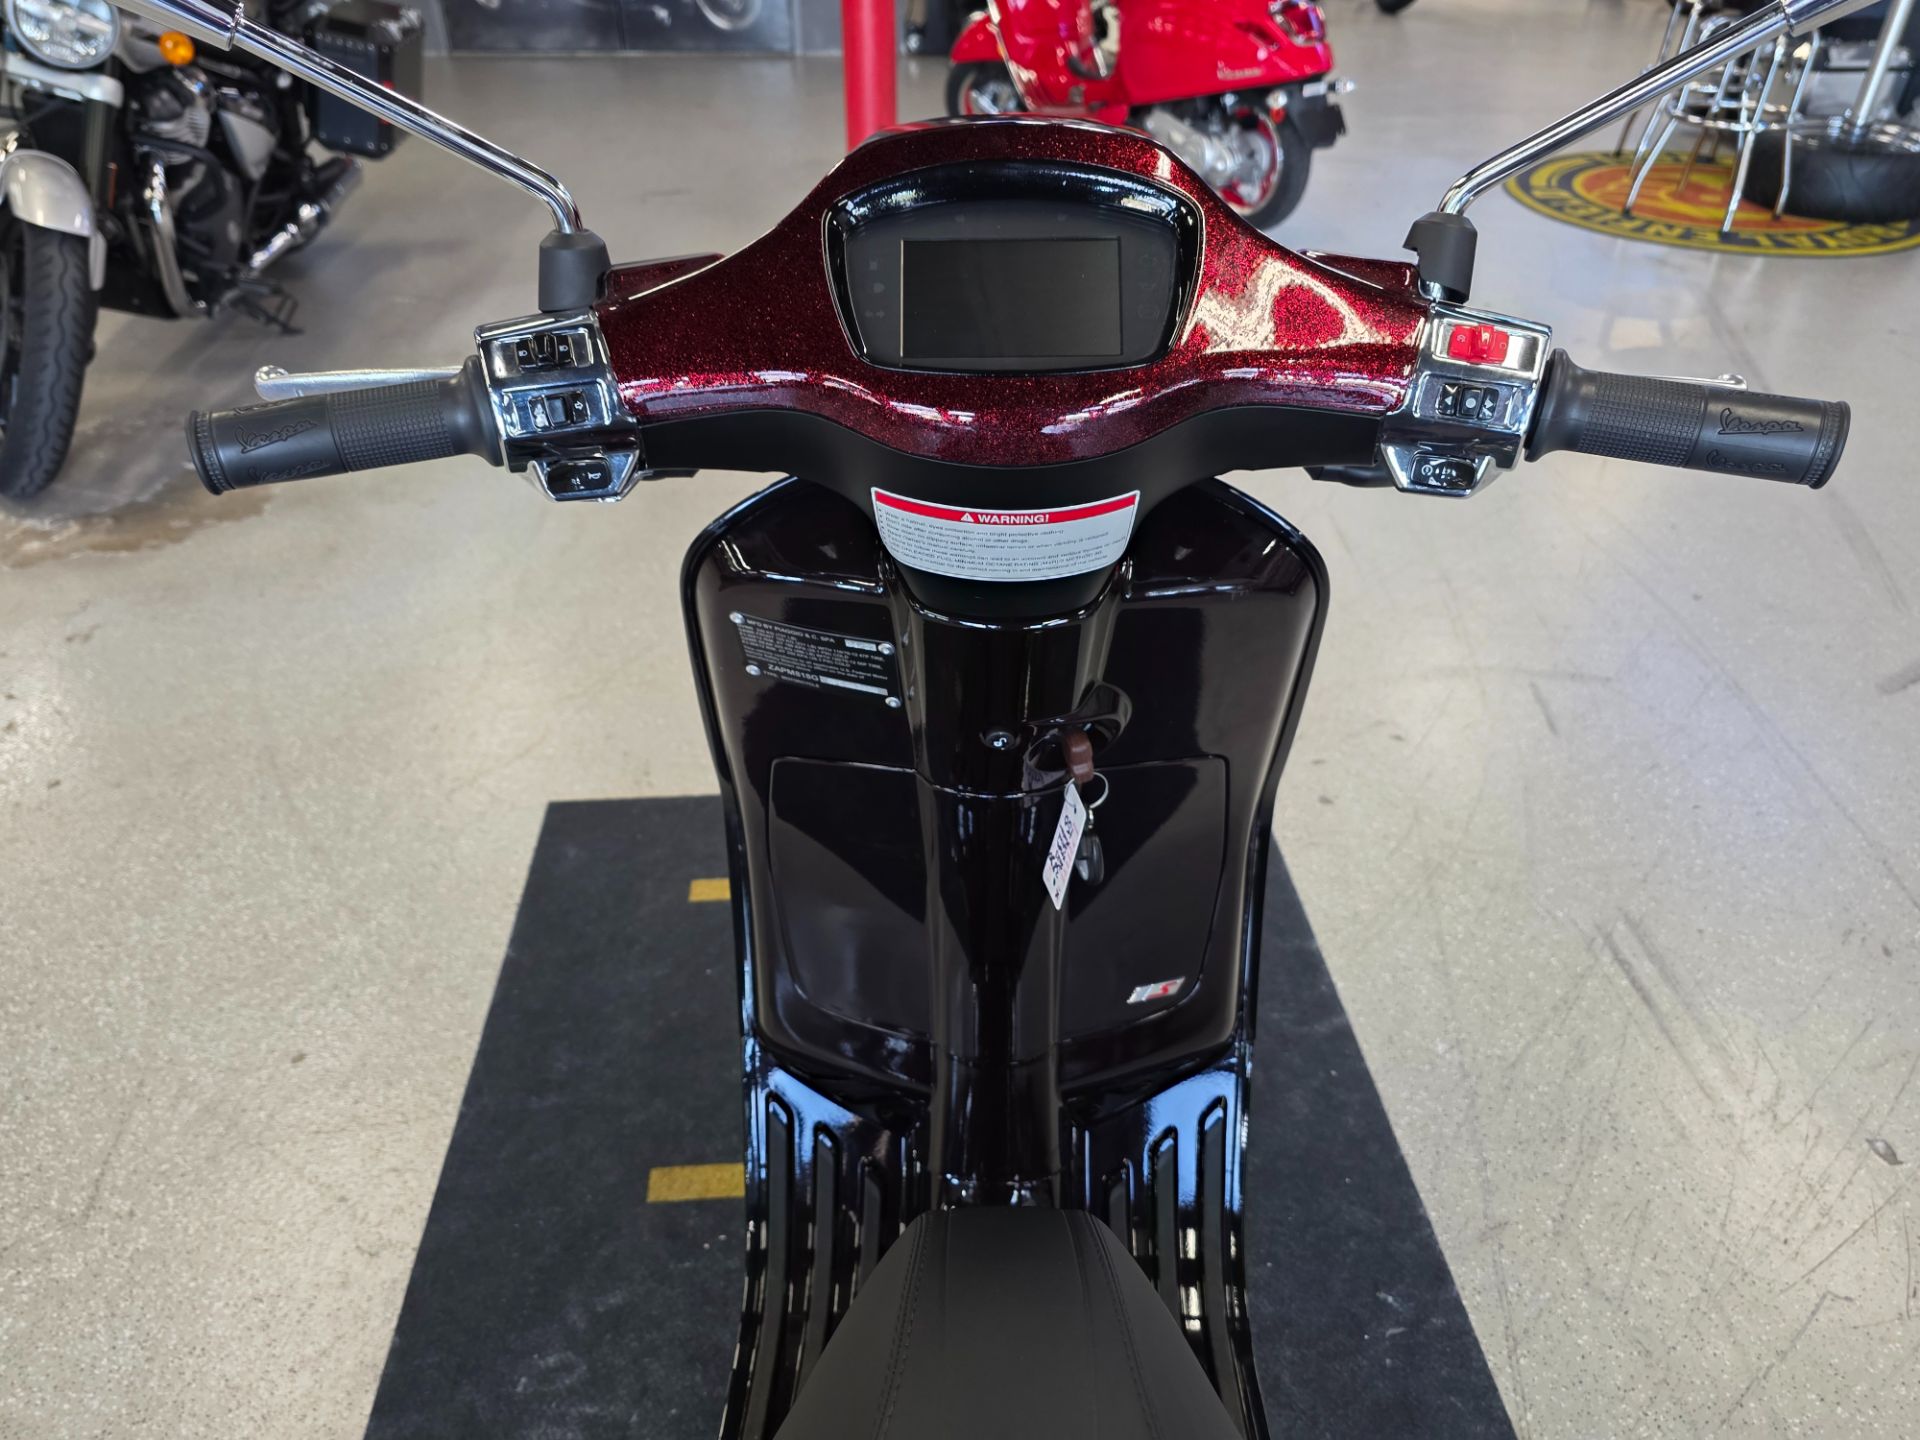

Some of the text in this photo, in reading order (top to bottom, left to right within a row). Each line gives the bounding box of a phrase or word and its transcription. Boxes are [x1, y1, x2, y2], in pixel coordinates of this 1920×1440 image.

[1718, 407, 1804, 435] Vespa
[234, 419, 319, 454] Vespa
[978, 514, 1049, 524] WARNING!
